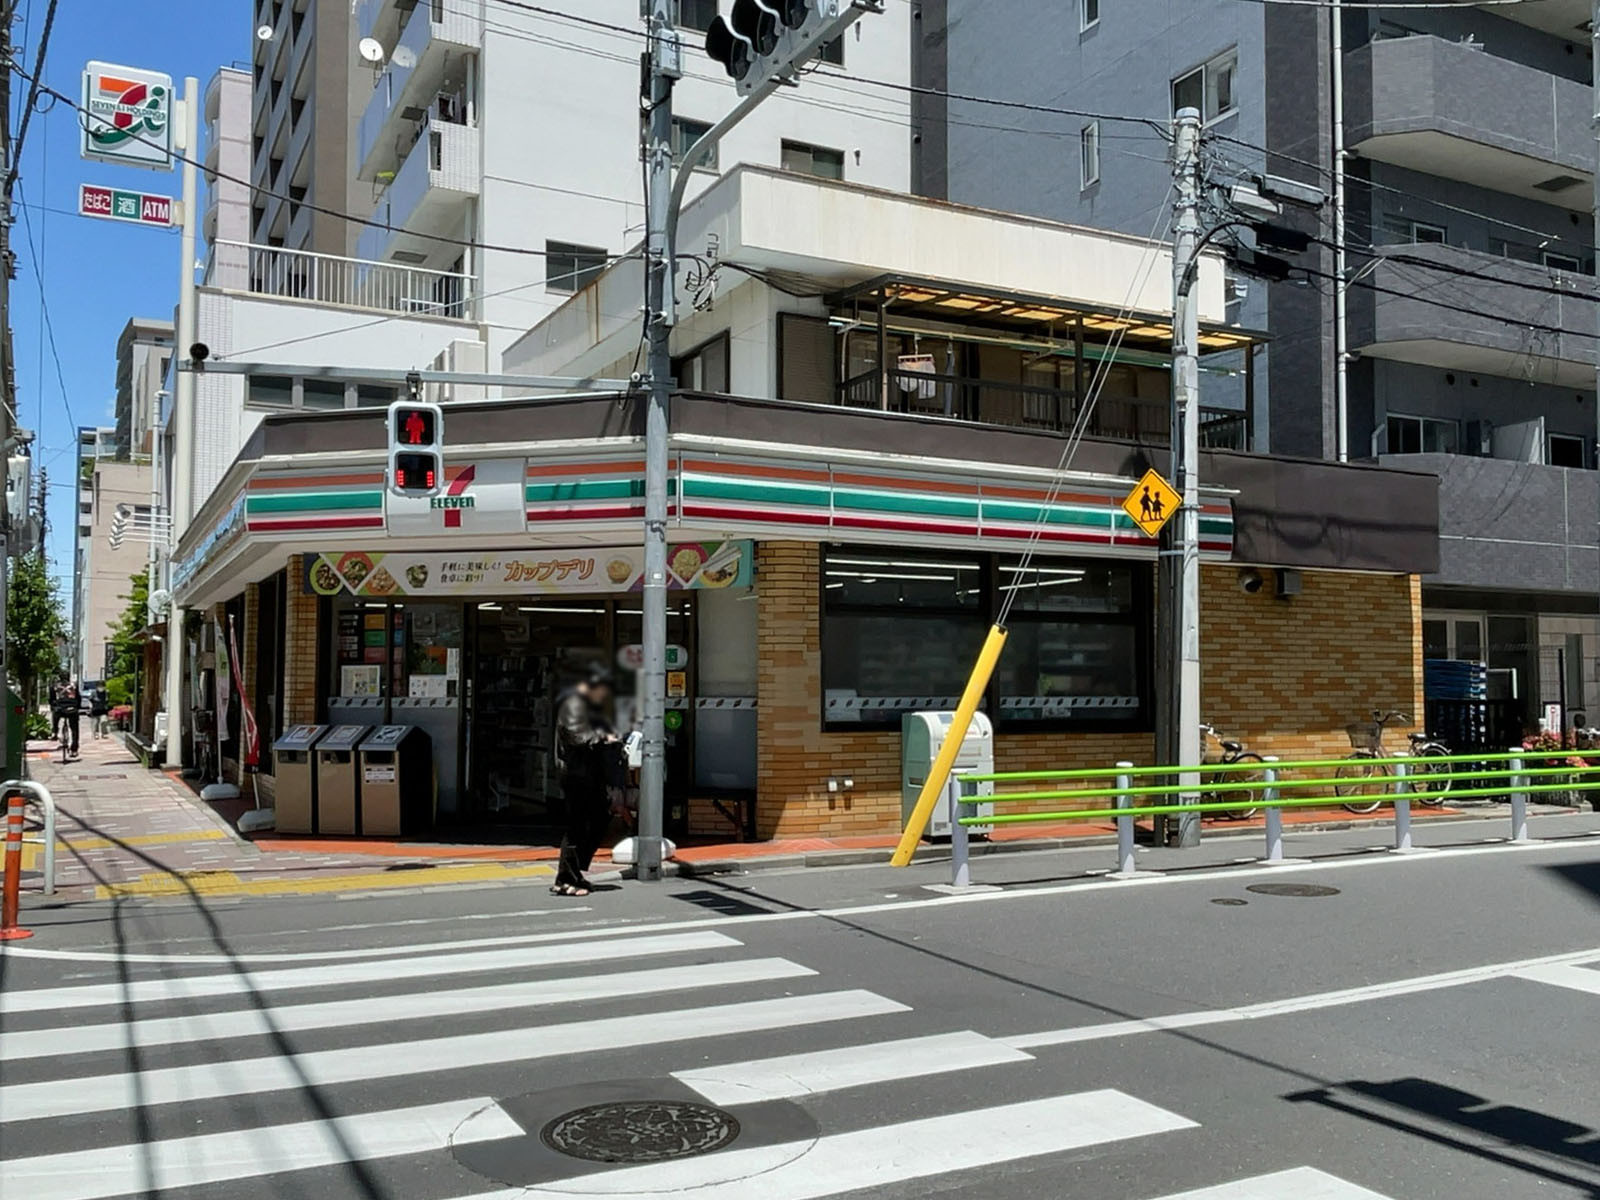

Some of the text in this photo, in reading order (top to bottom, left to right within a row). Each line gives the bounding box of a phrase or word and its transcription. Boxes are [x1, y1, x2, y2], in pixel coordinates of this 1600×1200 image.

[84, 192, 169, 220] たばこ 酒 ATM
[503, 558, 595, 582] カップデリ
